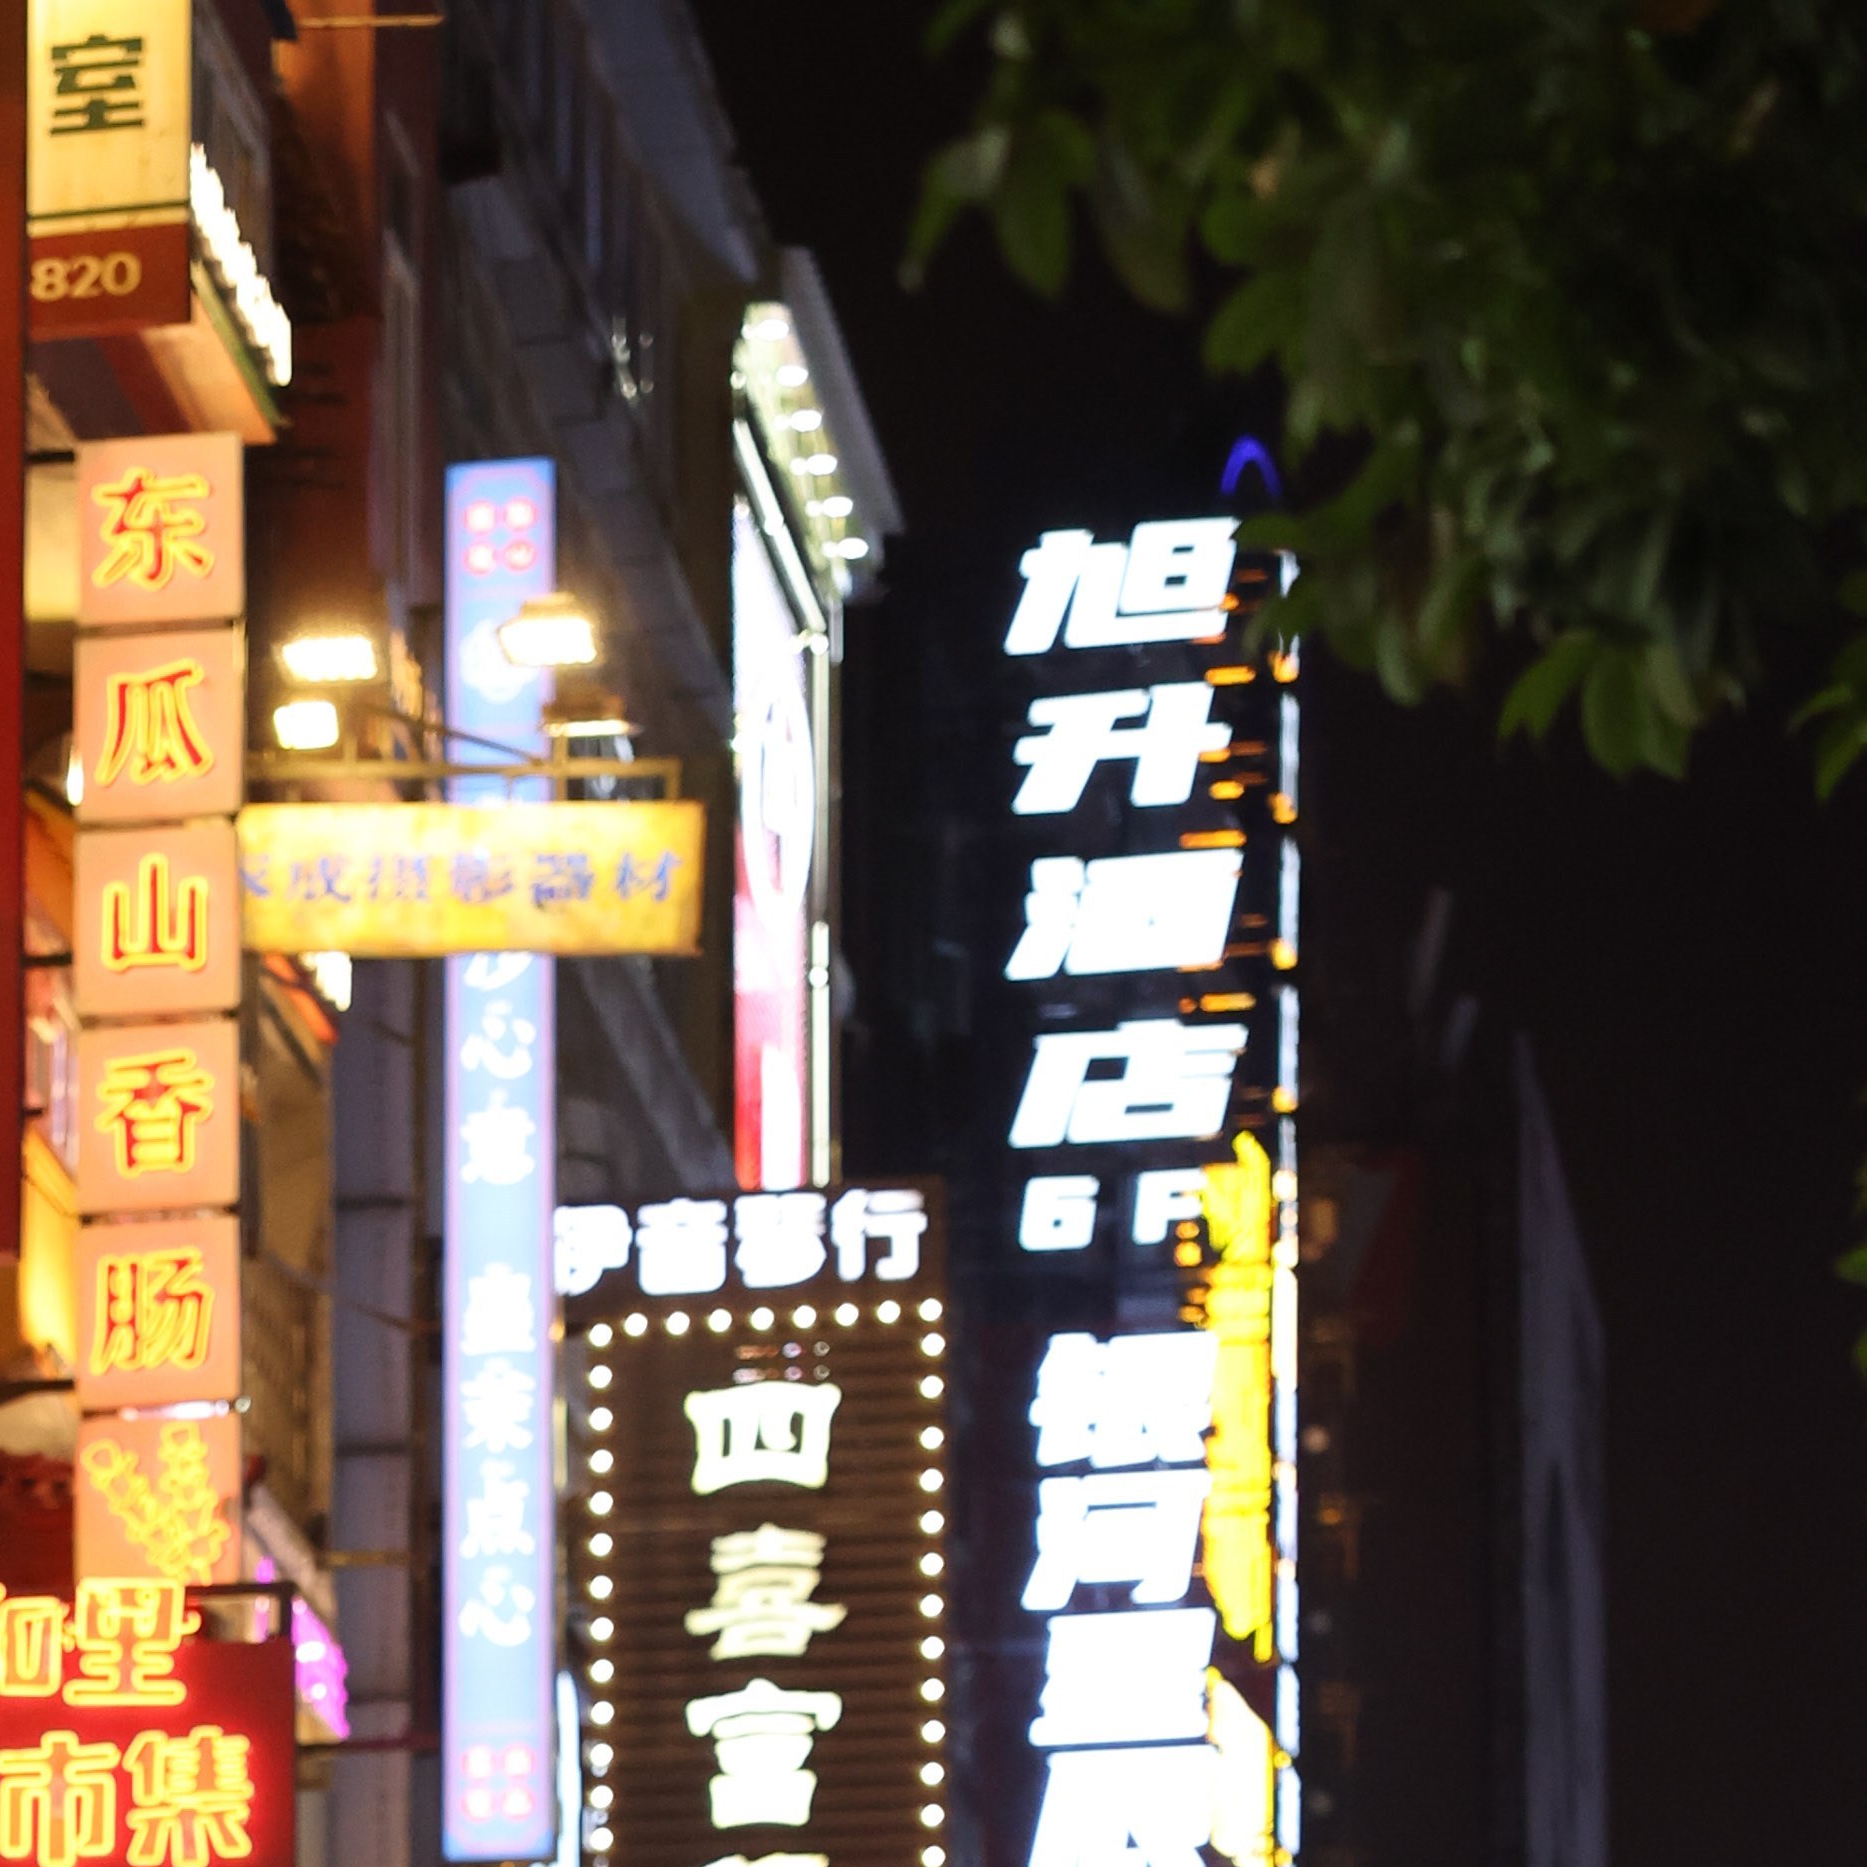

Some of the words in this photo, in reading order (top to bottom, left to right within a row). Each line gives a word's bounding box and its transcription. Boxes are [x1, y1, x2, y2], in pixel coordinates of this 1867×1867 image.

[50, 35, 146, 136] 室
[91, 467, 217, 1378] 东瓜山香肠
[1004, 516, 1248, 1148] 旭升酒店
